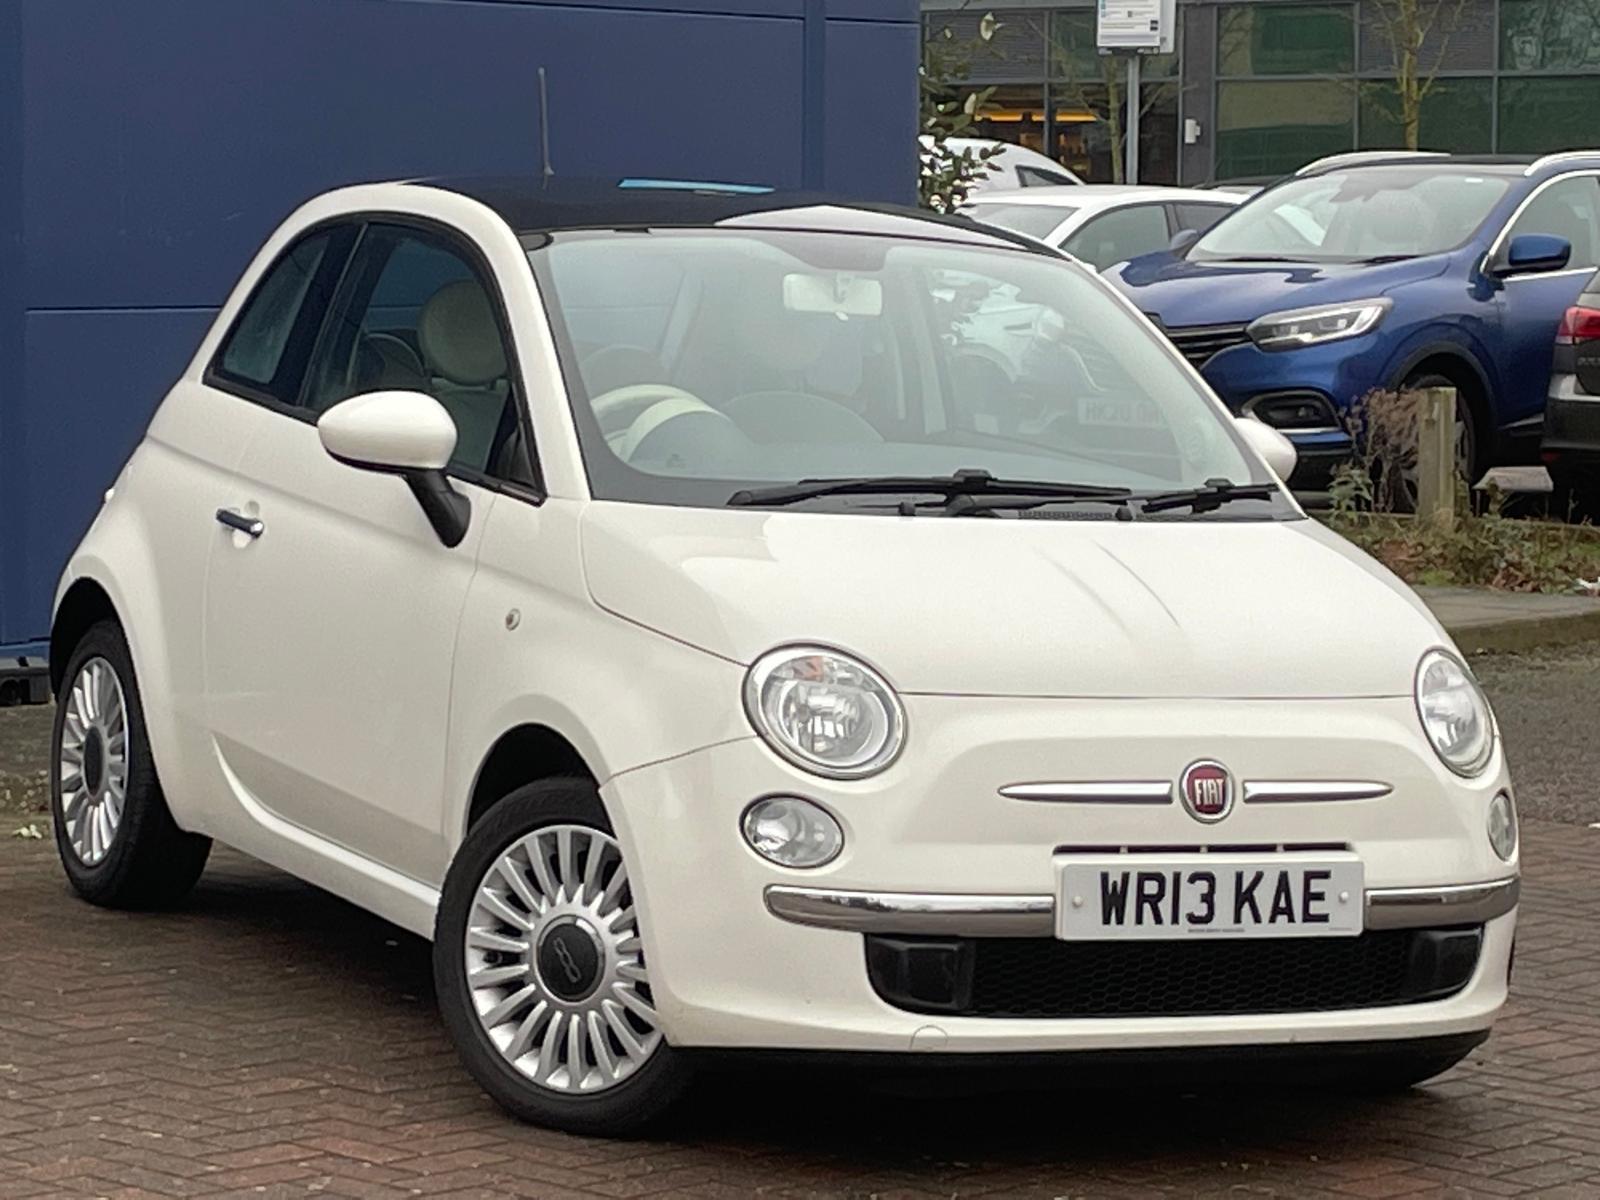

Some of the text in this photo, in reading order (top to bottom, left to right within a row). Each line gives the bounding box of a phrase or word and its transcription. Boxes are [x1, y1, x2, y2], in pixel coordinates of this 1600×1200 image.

[1194, 779, 1224, 805] FIAT
[1100, 870, 1332, 925] WR13 KAE
